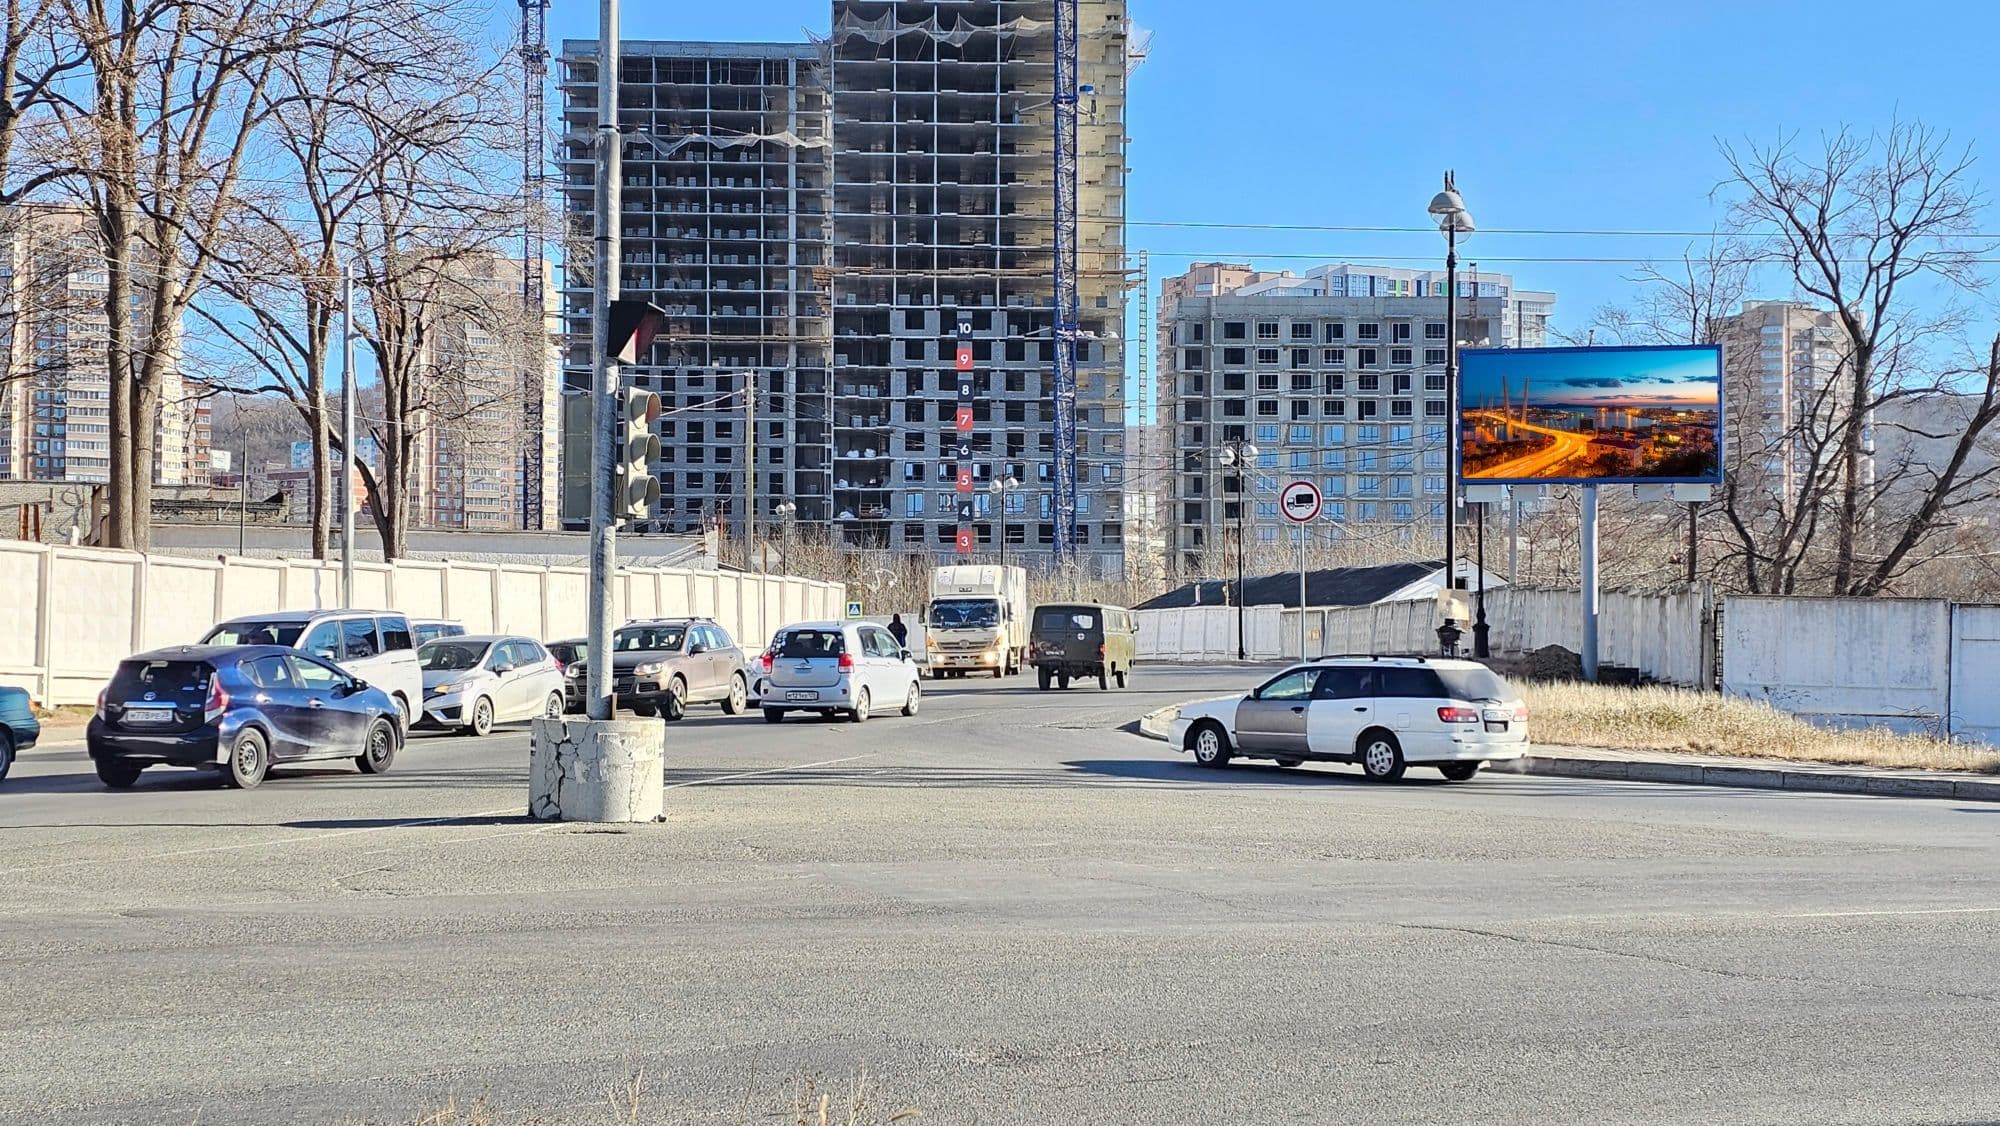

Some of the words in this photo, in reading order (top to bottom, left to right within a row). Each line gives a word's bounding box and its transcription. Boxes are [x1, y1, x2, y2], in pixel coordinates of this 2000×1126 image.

[958, 322, 972, 334] 10
[960, 353, 969, 365] 9
[961, 384, 970, 396] 8
[960, 414, 969, 426] 7
[960, 444, 969, 455] 6
[960, 474, 969, 486] 5
[961, 505, 970, 517] 4
[960, 535, 969, 547] 3
